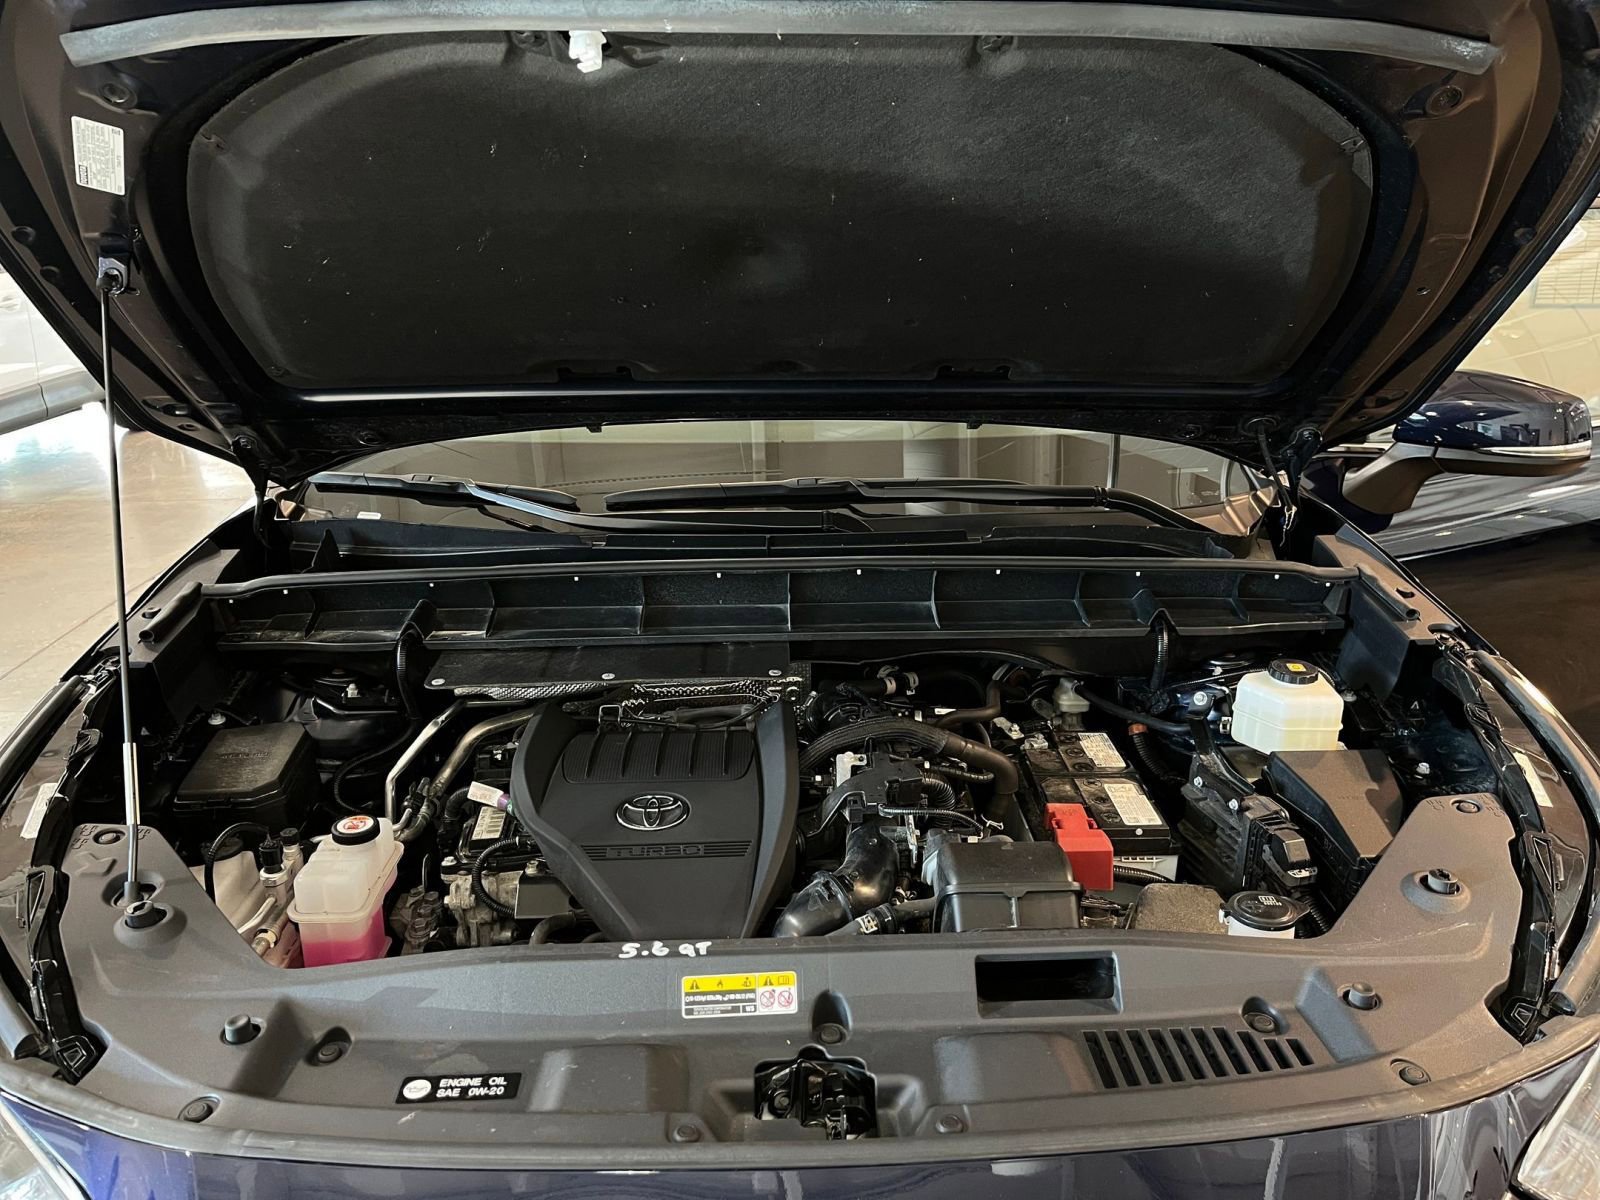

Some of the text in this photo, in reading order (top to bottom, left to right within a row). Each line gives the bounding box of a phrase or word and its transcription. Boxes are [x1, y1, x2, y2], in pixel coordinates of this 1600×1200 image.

[610, 845, 701, 857] TURBO
[439, 1076, 507, 1088] ENGINE OIL
[435, 1086, 504, 1098] SAE 0W-20
